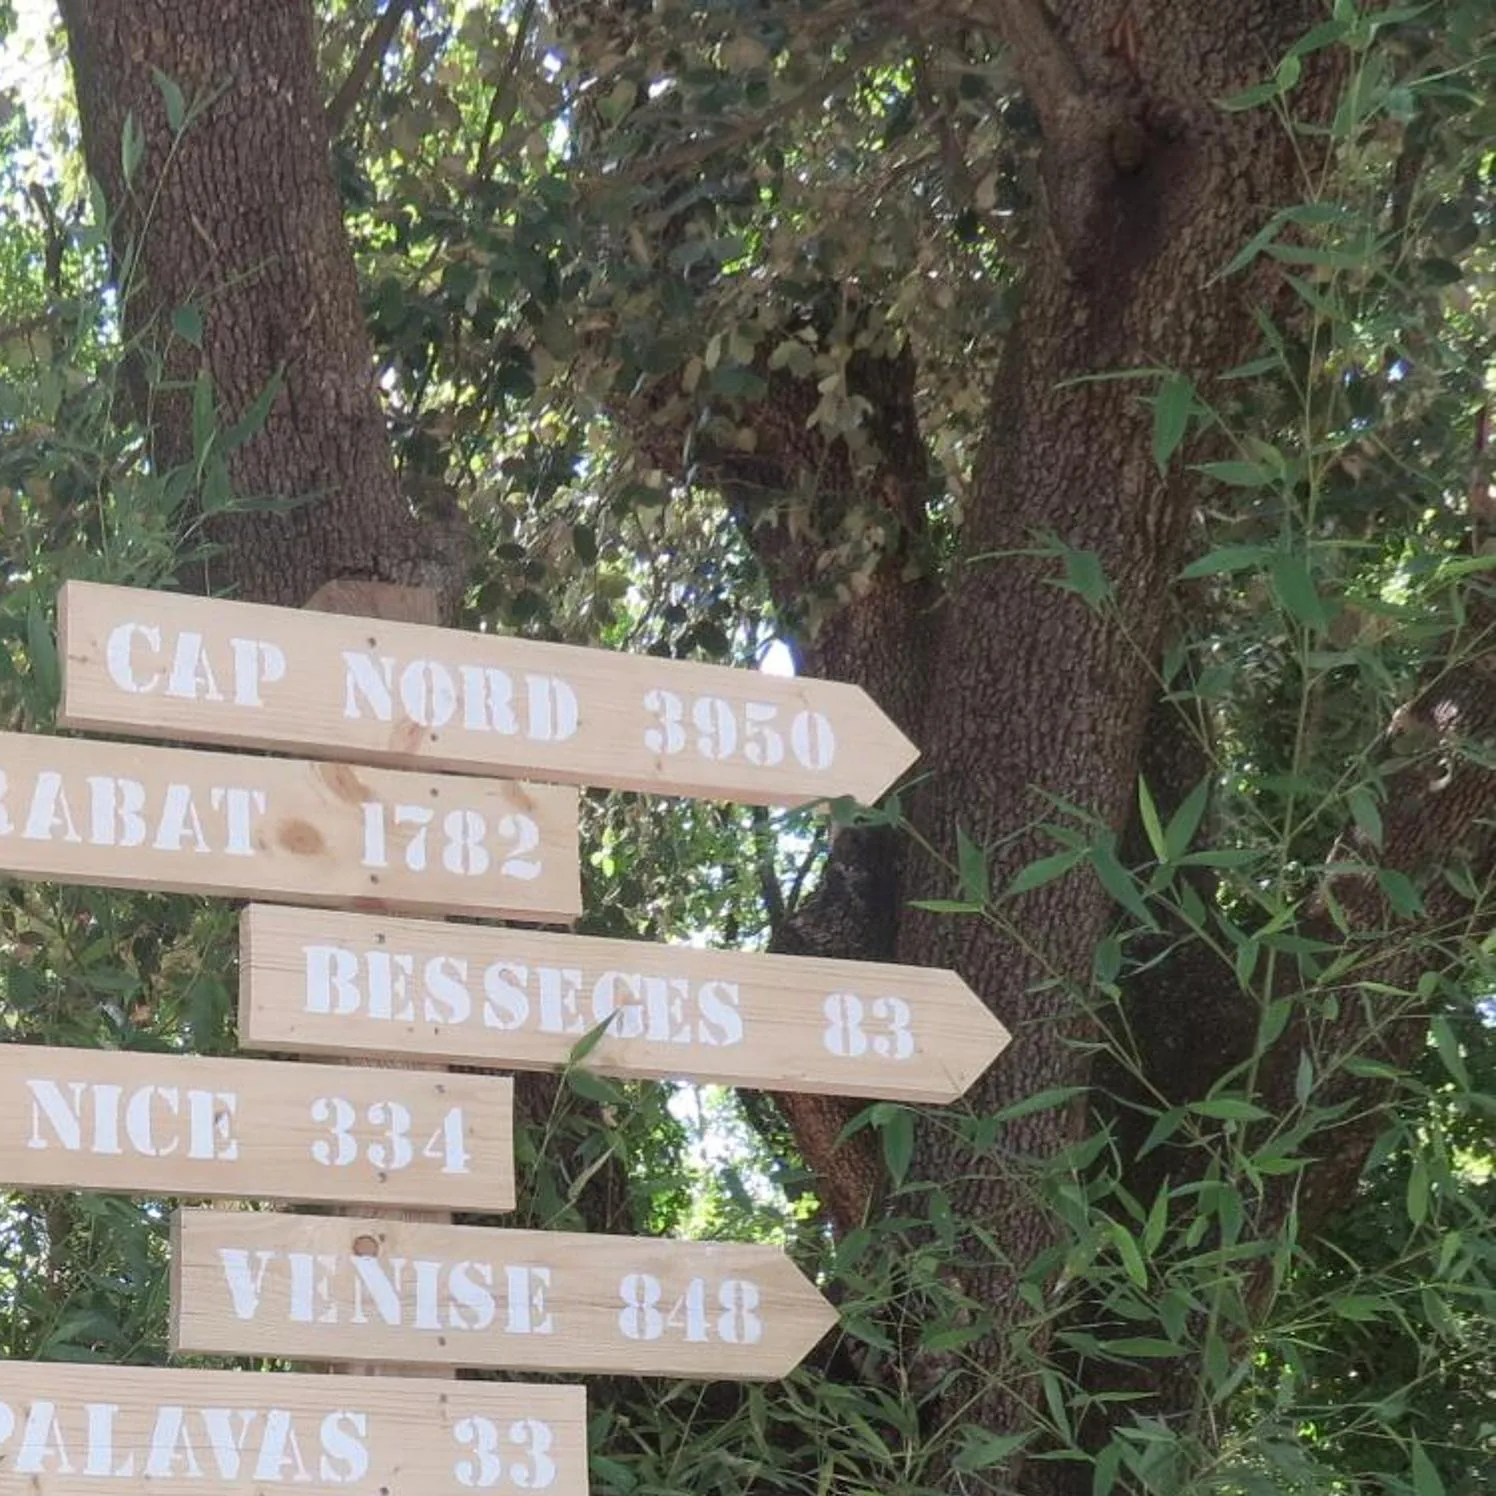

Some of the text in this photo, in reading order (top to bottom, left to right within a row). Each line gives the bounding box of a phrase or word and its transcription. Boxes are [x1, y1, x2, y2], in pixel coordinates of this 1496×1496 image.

[106, 622, 837, 772] CAP NORD 3950
[360, 801, 543, 884] 1782
[302, 945, 916, 1062] BESSEGES 83
[26, 1079, 472, 1176] NICE 334
[218, 1247, 764, 1346] VENISE 848
[453, 1417, 557, 1491] 33
